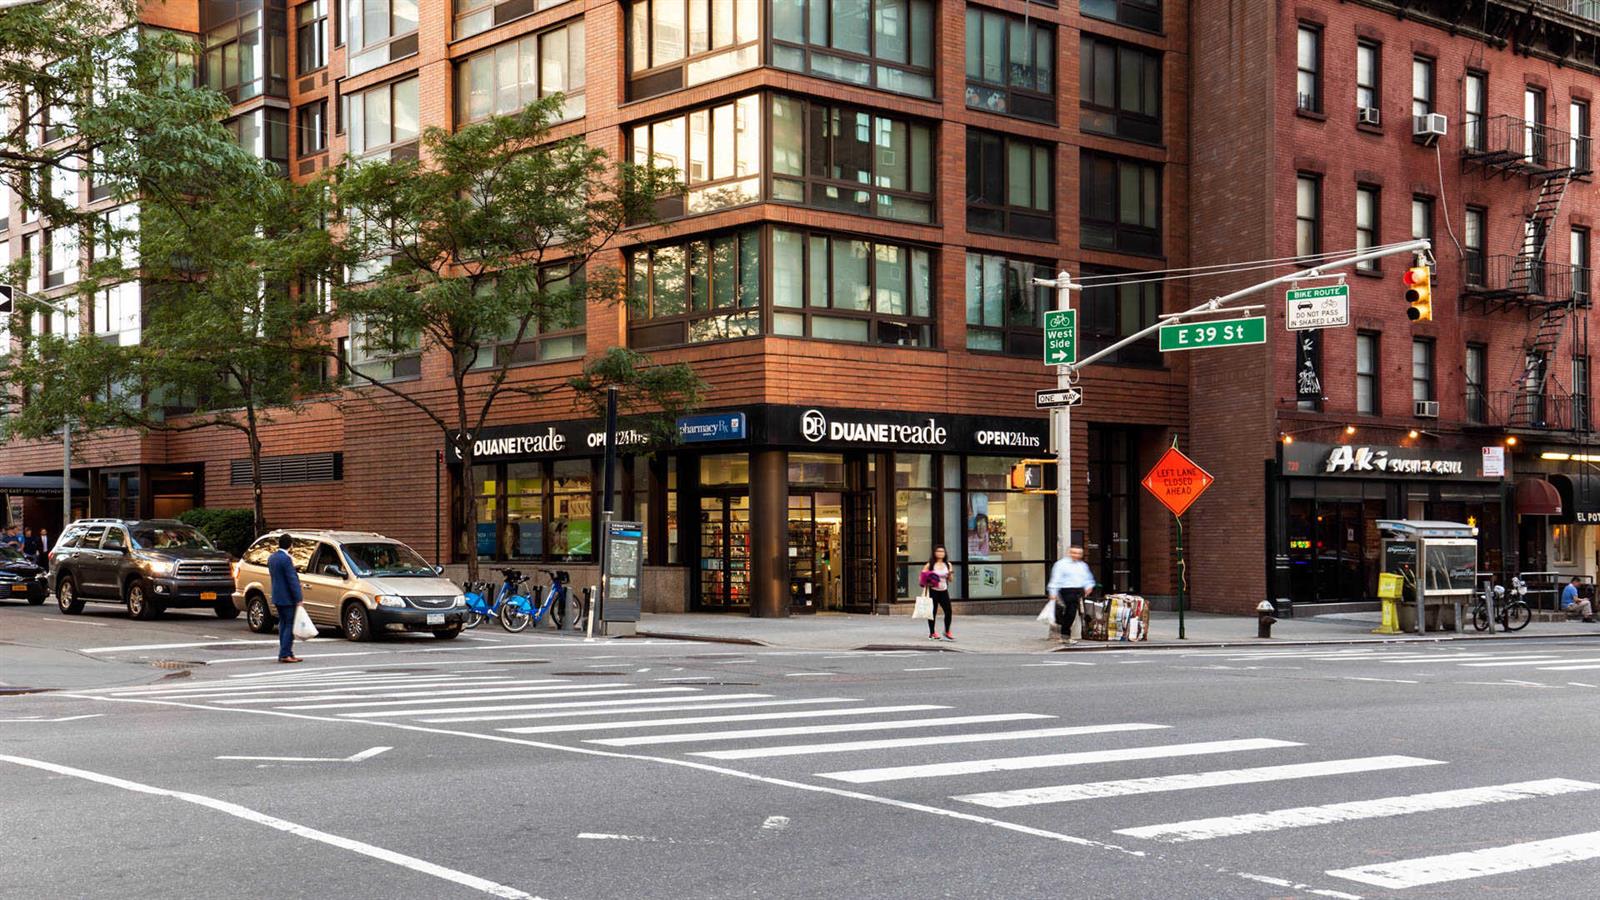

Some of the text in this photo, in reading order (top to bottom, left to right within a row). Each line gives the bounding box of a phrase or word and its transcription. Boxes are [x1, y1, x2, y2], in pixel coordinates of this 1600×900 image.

[1294, 287, 1341, 299] BIKE ROUTE
[1321, 309, 1338, 317] PASS
[1299, 318, 1324, 326] SHARED
[1326, 316, 1344, 324] LANE
[1047, 329, 1073, 340] West
[1178, 325, 1244, 344] E 39 St
[1050, 340, 1071, 349] Side
[1039, 393, 1077, 403] ONE WAY
[1157, 468, 1196, 478] LEFT LANE
[1164, 478, 1193, 487] CLOSED
[1166, 487, 1192, 495] AHEAD
[1577, 512, 1587, 522] EL
